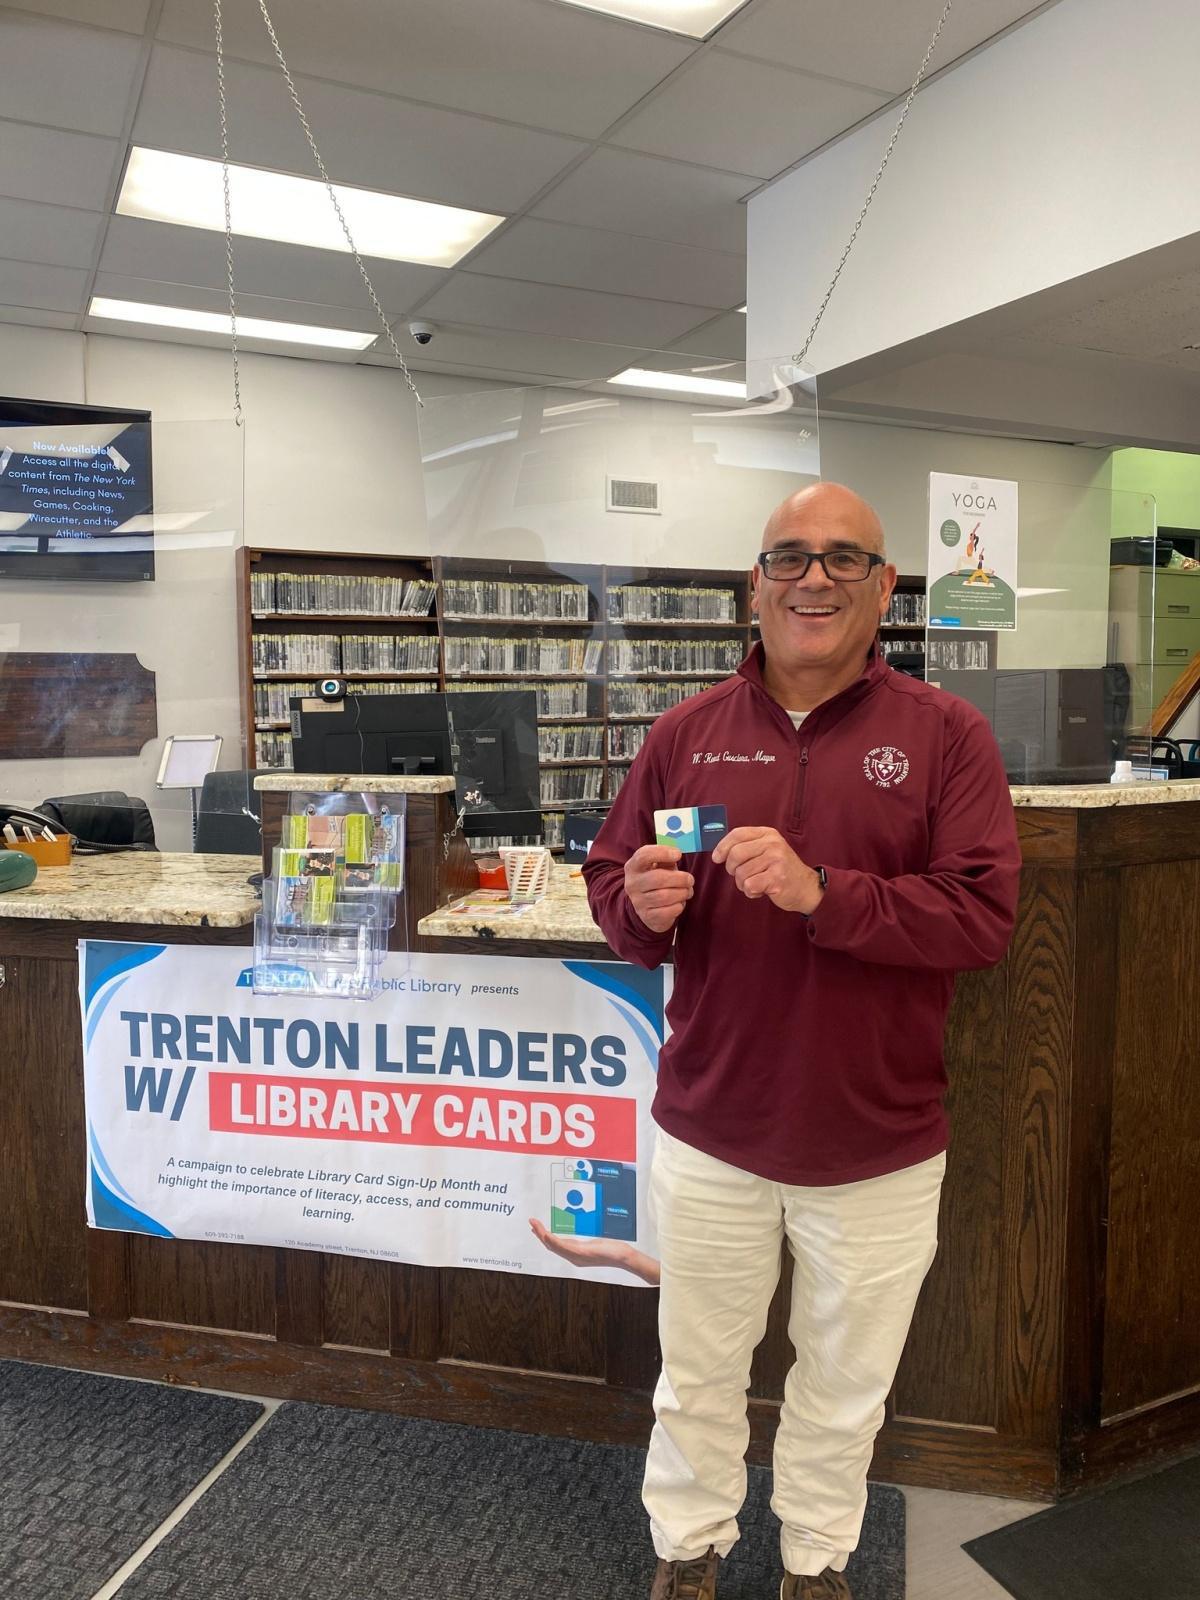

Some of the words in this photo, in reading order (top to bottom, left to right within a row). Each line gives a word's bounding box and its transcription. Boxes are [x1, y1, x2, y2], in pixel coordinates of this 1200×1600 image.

[33, 441, 55, 450] Now
[22, 455, 57, 466] Access
[59, 458, 71, 467] all
[73, 459, 89, 468] the
[91, 460, 120, 471] digita
[8, 471, 45, 479] content
[49, 471, 70, 481] from
[74, 473, 90, 482] The
[92, 474, 113, 484] New
[116, 476, 136, 486] York
[21, 484, 51, 495] Times,
[53, 486, 95, 499] including
[97, 489, 125, 500] News,
[33, 499, 70, 510] Games,
[72, 501, 114, 514] Cooking,
[952, 492, 997, 510] YOGA
[28, 513, 81, 525] Wirecutter,
[83, 518, 101, 526] and
[103, 518, 119, 526] the
[55, 529, 95, 539] Athletic.
[868, 747, 881, 756] THE
[410, 978, 461, 996] Library
[471, 983, 520, 996] presents
[120, 1010, 361, 1071] TRENTON
[374, 1021, 628, 1087] LEADERS
[123, 1065, 196, 1122] W/
[230, 1082, 424, 1136] LIBRARY
[433, 1092, 596, 1148] CARDS
[166, 1156, 175, 1167] A
[178, 1158, 233, 1175] campaign
[236, 1164, 247, 1174] to
[250, 1165, 304, 1179] celebrate
[307, 1169, 351, 1185] Library
[354, 1172, 384, 1185] Card
[387, 1175, 438, 1191] Sign-Up
[441, 1178, 481, 1192] Month
[483, 1183, 508, 1194] and
[158, 1173, 207, 1188] highlight
[210, 1179, 228, 1190] the
[231, 1181, 297, 1197] importance
[300, 1187, 313, 1198] of
[315, 1187, 363, 1205] literacy,
[366, 1194, 412, 1208] access,
[416, 1197, 441, 1208] and
[444, 1200, 515, 1216] community
[302, 1206, 355, 1223] learning.
[296, 1241, 324, 1249] Academy
